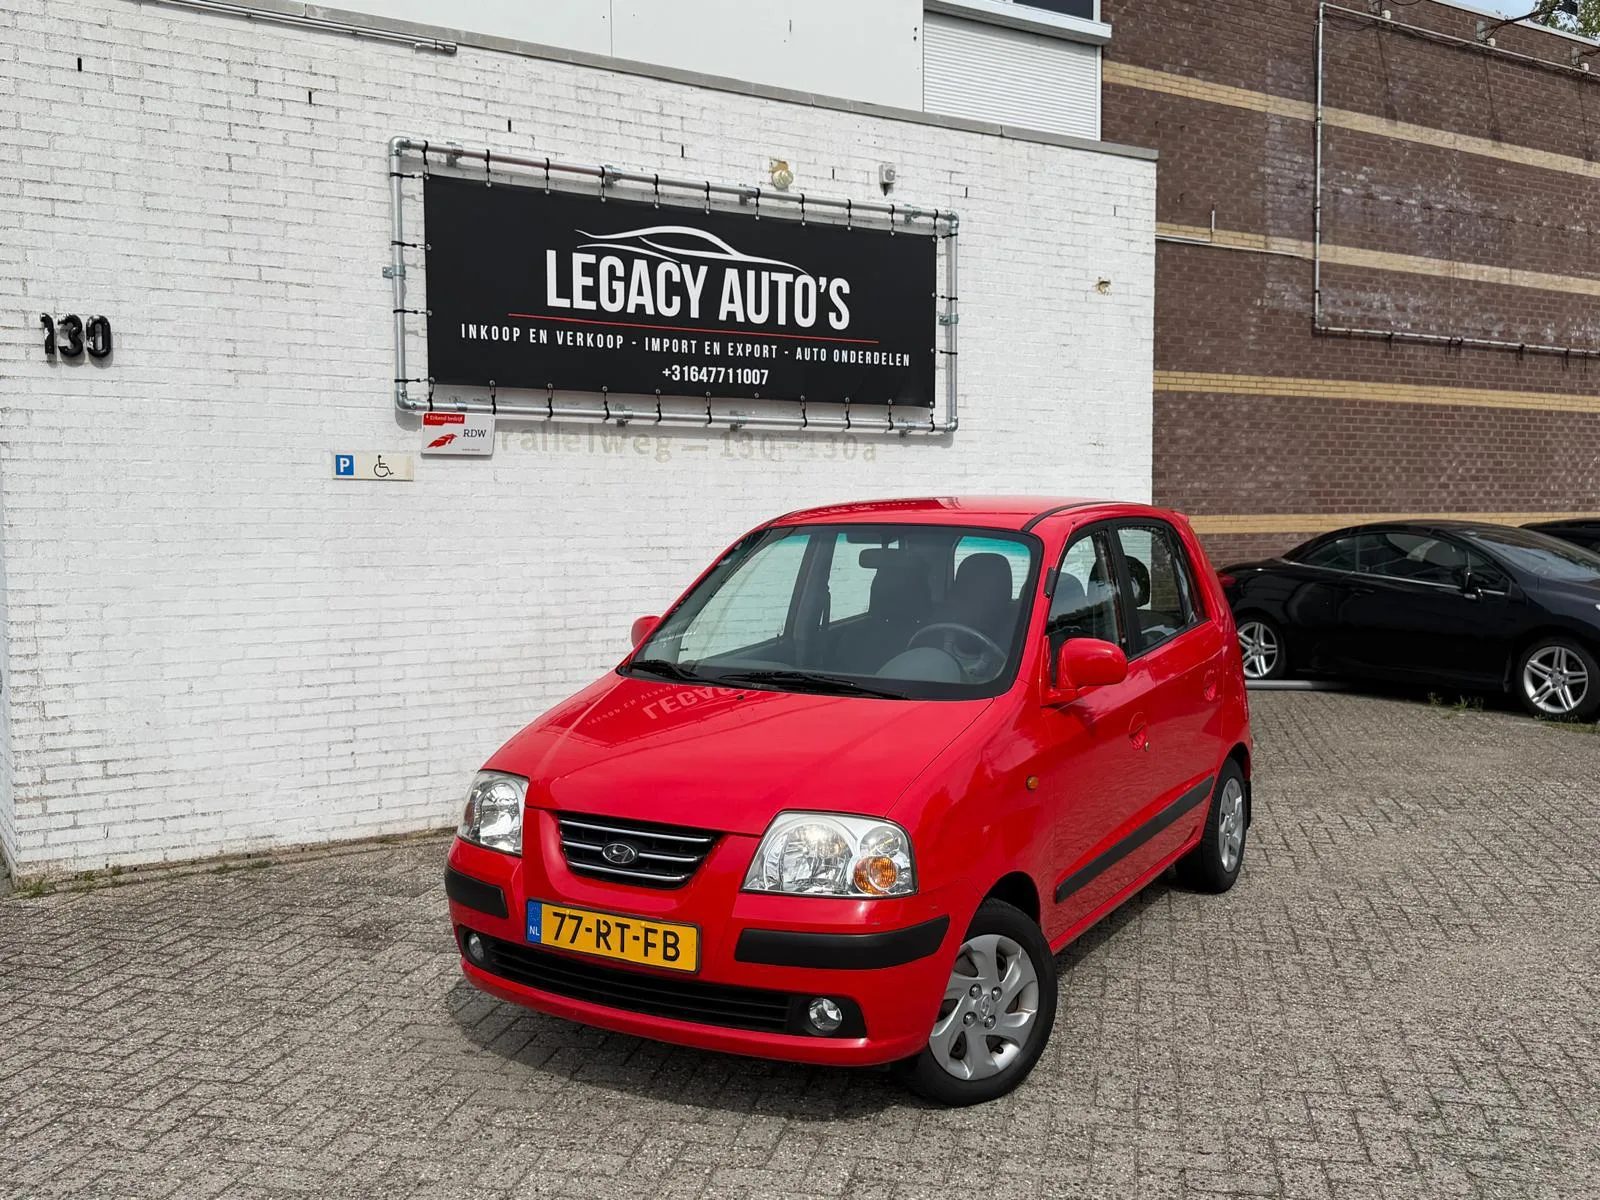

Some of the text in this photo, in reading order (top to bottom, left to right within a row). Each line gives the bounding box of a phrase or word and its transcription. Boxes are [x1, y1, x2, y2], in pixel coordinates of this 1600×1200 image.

[546, 249, 850, 330] LEGACY AUTO'S
[40, 312, 112, 358] 130
[461, 323, 521, 342] INKOOP
[529, 328, 548, 344] EN
[556, 331, 624, 349] VERKOOP
[645, 337, 697, 354] IMPORT
[704, 341, 721, 356] EN
[728, 342, 778, 359] EXPORT
[795, 347, 827, 362] AUTO
[833, 350, 910, 367] ONDERDELEN
[662, 365, 769, 385] +31647711007
[463, 428, 487, 438] RDW
[501, 421, 672, 463] rallelweg
[339, 457, 350, 472] P
[529, 925, 541, 936] NL
[552, 911, 681, 962] 77-RT-FB
